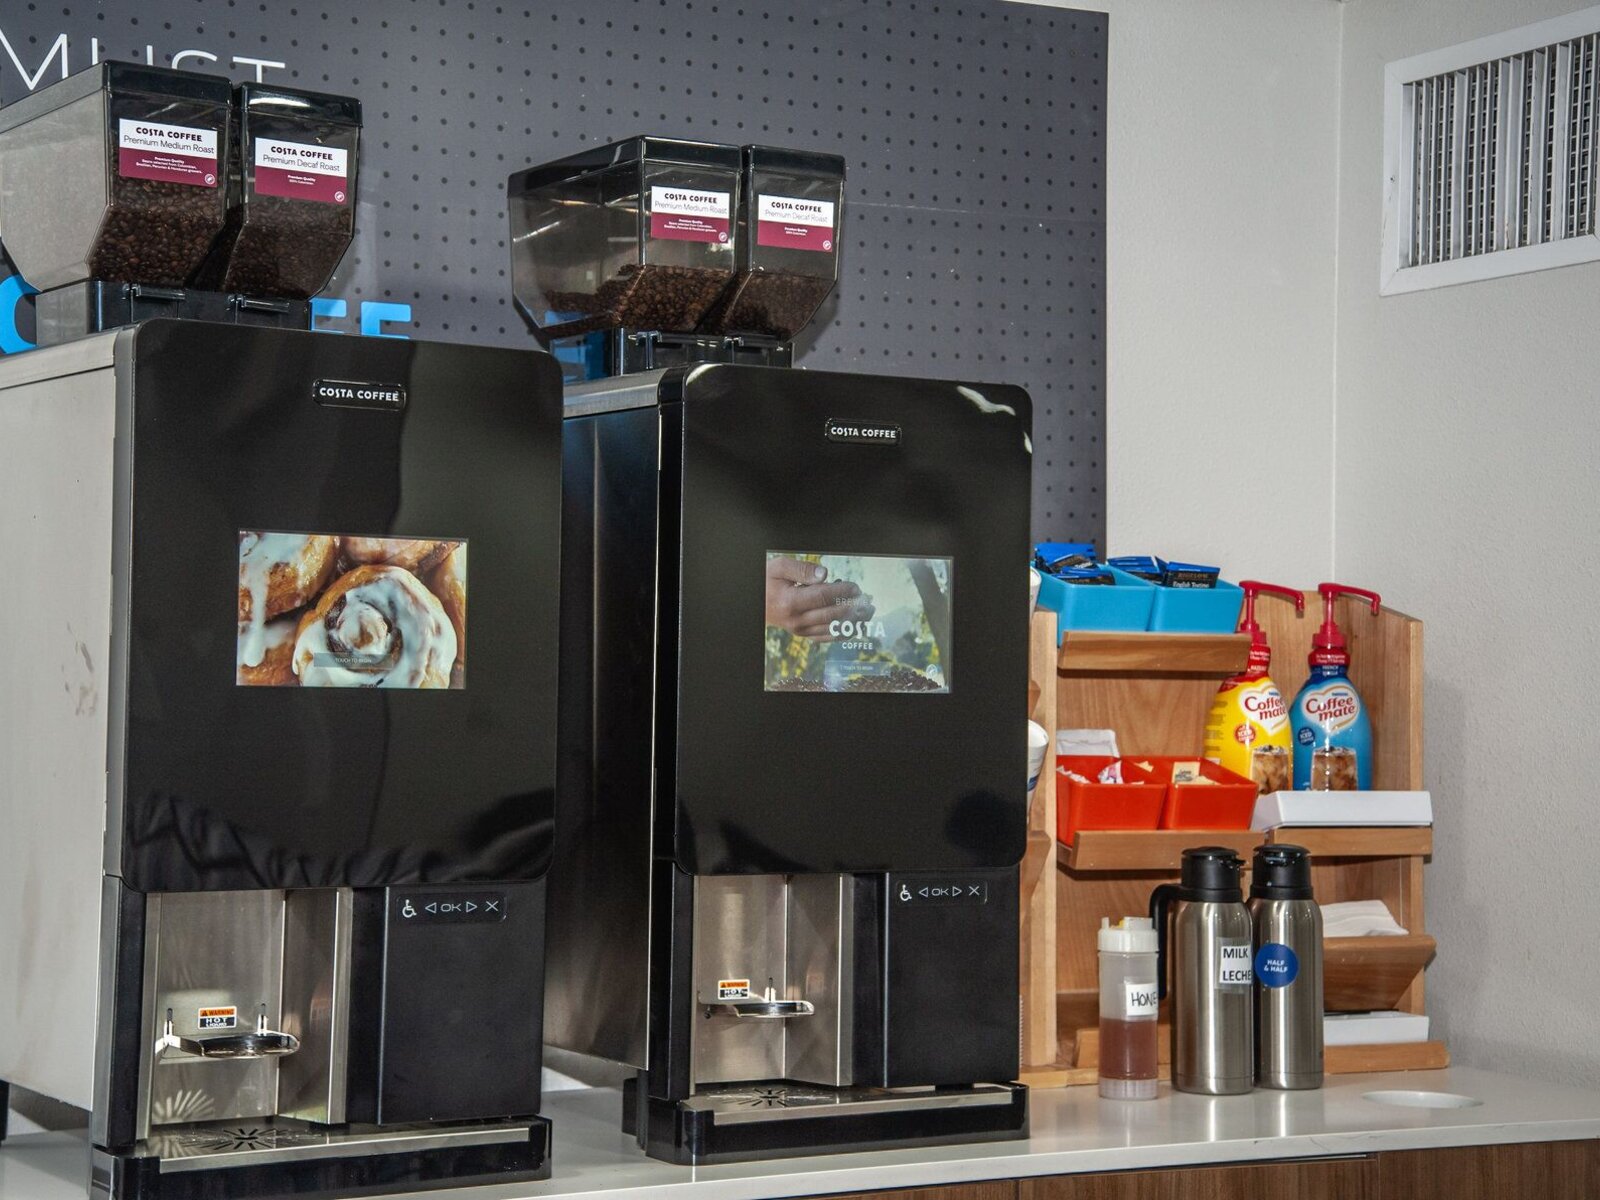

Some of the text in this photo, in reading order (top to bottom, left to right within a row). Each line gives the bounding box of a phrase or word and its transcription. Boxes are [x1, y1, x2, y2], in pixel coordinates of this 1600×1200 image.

[136, 127, 203, 142] COSTA COFFEE
[123, 135, 214, 154] Premium Medium Roast
[271, 146, 333, 160] COSTA COFFEE
[263, 154, 340, 172] Premium Decaf Roast
[664, 193, 717, 204] COSTA COFFEE
[655, 201, 727, 214] Premium Medium Roast
[771, 201, 822, 212] COSTA COFFEE
[319, 387, 399, 402] COSTA COFFEE
[831, 427, 896, 438] COSTA COFFEE
[829, 620, 886, 640] COSTA
[841, 642, 873, 650] COFFEE
[1244, 696, 1283, 712] Coffee
[1306, 696, 1353, 714] Coffee
[1259, 707, 1286, 720] mate
[1319, 705, 1355, 722] mate
[931, 888, 949, 896] OK
[441, 903, 461, 912] OK
[1223, 948, 1248, 959] MILK
[1222, 970, 1252, 981] LECHE
[1130, 991, 1157, 1007] HONE
[209, 1008, 234, 1016] WARNING
